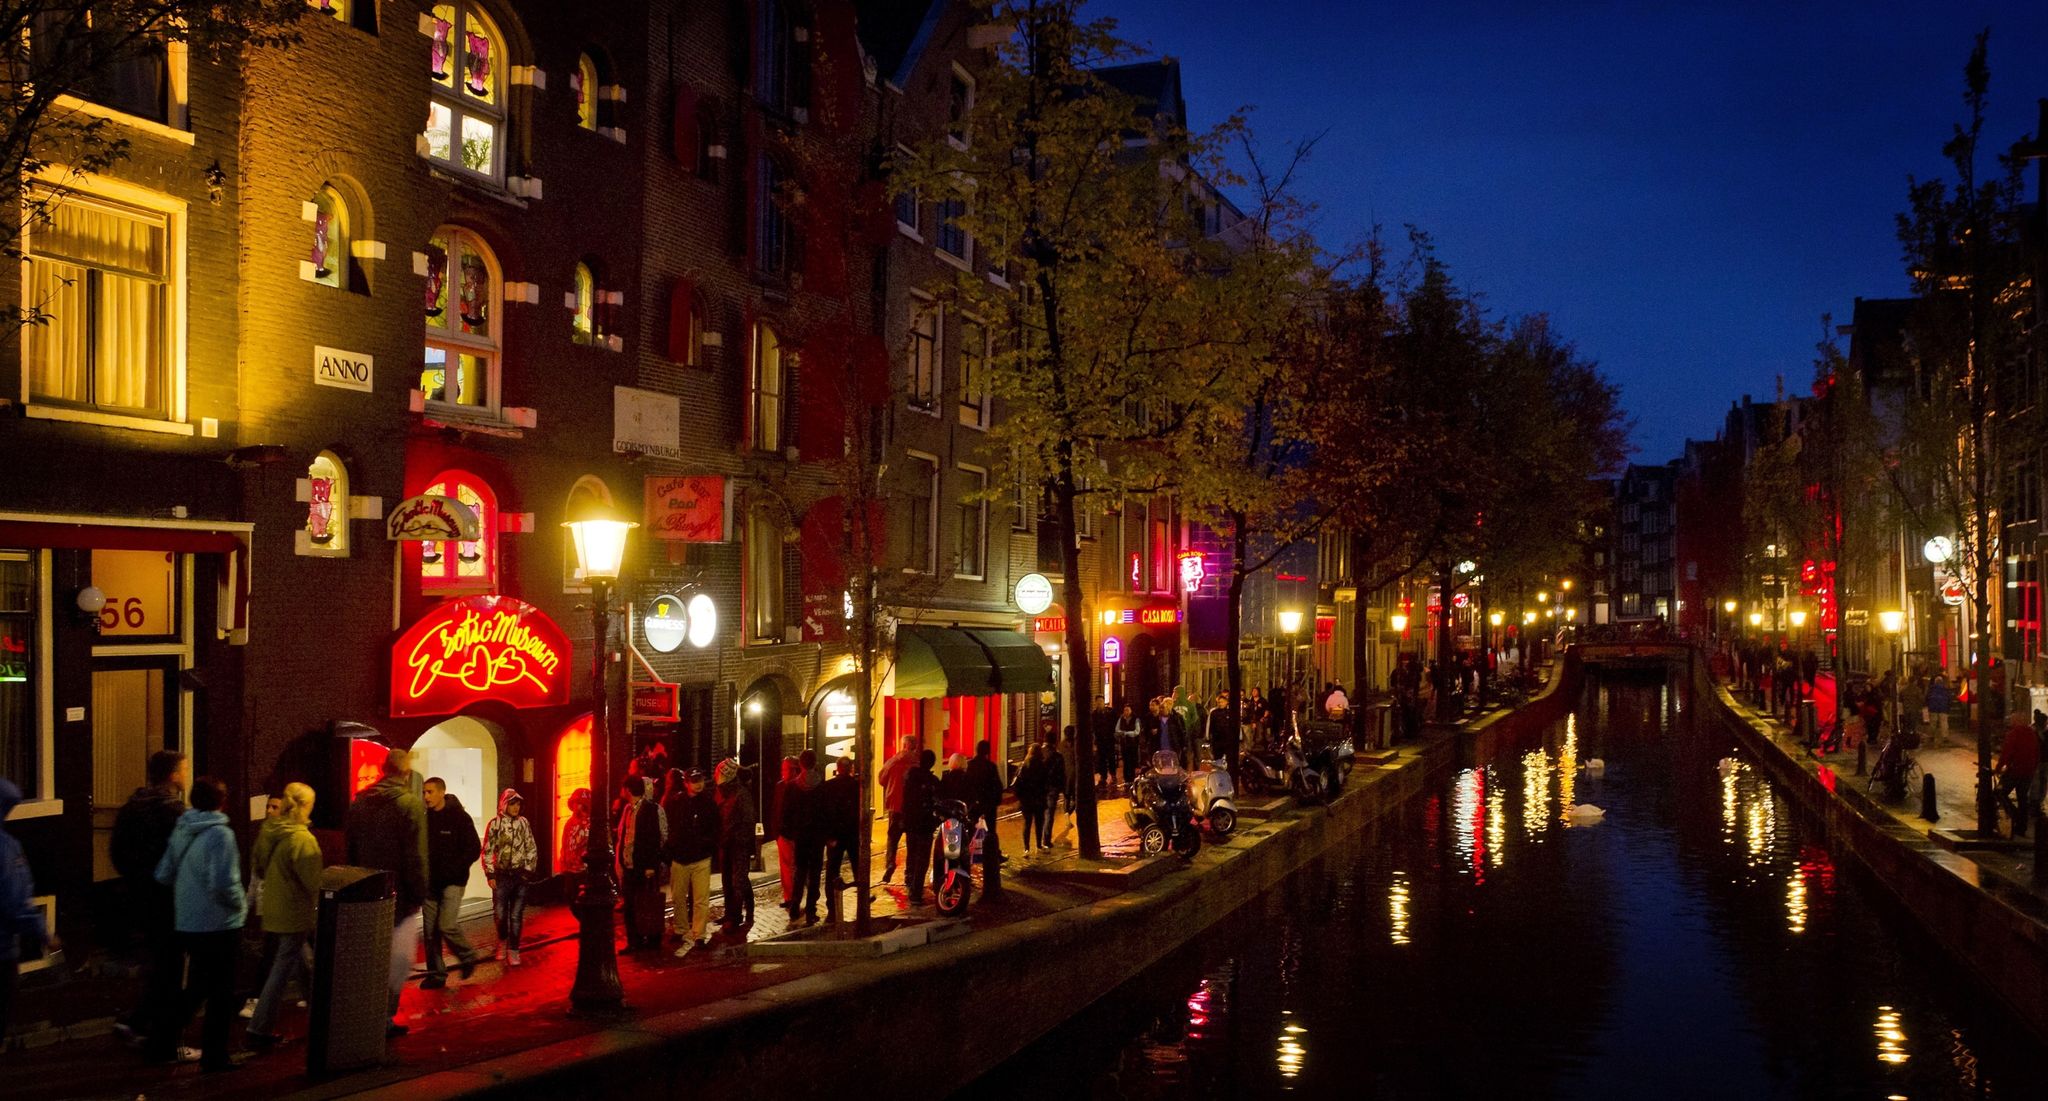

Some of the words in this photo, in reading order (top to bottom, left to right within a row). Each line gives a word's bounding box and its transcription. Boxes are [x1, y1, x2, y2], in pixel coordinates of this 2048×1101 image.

[319, 356, 369, 382] ANNO
[100, 597, 145, 629] 56
[1142, 609, 1160, 624] CASA
[409, 609, 493, 698] Erotic
[491, 610, 559, 676] Museum
